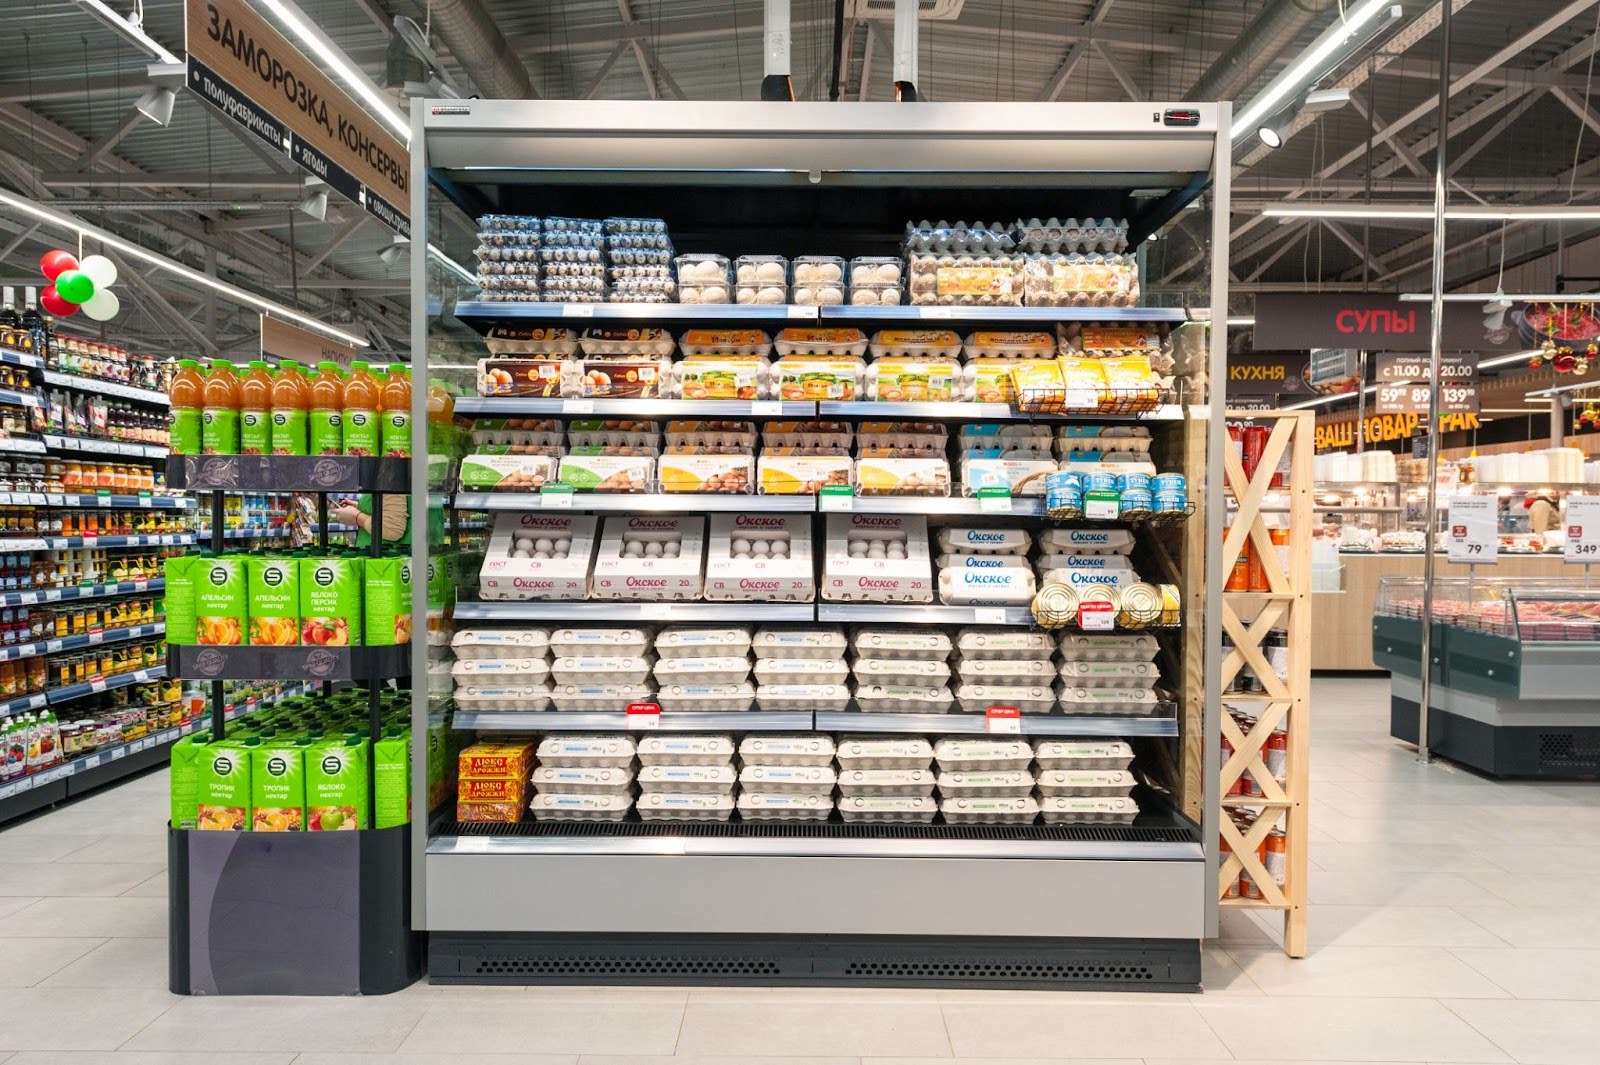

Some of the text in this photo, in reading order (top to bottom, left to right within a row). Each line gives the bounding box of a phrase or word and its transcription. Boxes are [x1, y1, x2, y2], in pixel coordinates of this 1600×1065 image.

[207, 3, 408, 194] ЗАМОРОЗКА, КОНСЕРВЫ
[203, 77, 281, 147] полуфабрикаты
[302, 148, 328, 178] ягоды
[1335, 309, 1416, 334] СУПЫ
[1230, 366, 1285, 380] КУХНЯ
[1441, 366, 1473, 376] 20.00
[1316, 421, 1353, 449] ВАШ
[520, 514, 572, 526] Окское
[628, 517, 679, 527] Окское
[735, 514, 786, 526] Окское
[852, 513, 902, 525] Окское
[967, 530, 1006, 541] Окское
[1070, 530, 1110, 541] Окское
[1467, 545, 1482, 553] 79
[1575, 545, 1597, 554] 349
[965, 556, 1004, 567] Окское
[1067, 555, 1106, 566] Окское
[513, 577, 555, 588] Окское
[626, 576, 667, 587] Окское
[858, 576, 899, 588] Окское
[964, 571, 1012, 583] Окское
[1071, 571, 1119, 584] Окское
[739, 578, 780, 589] Окское
[474, 758, 504, 767] ЛЮКС
[209, 783, 236, 792] ТРОПИК
[317, 783, 346, 791] ЯБЛОКО
[473, 782, 502, 790] ЛЮКС
[320, 791, 343, 799] нектар
